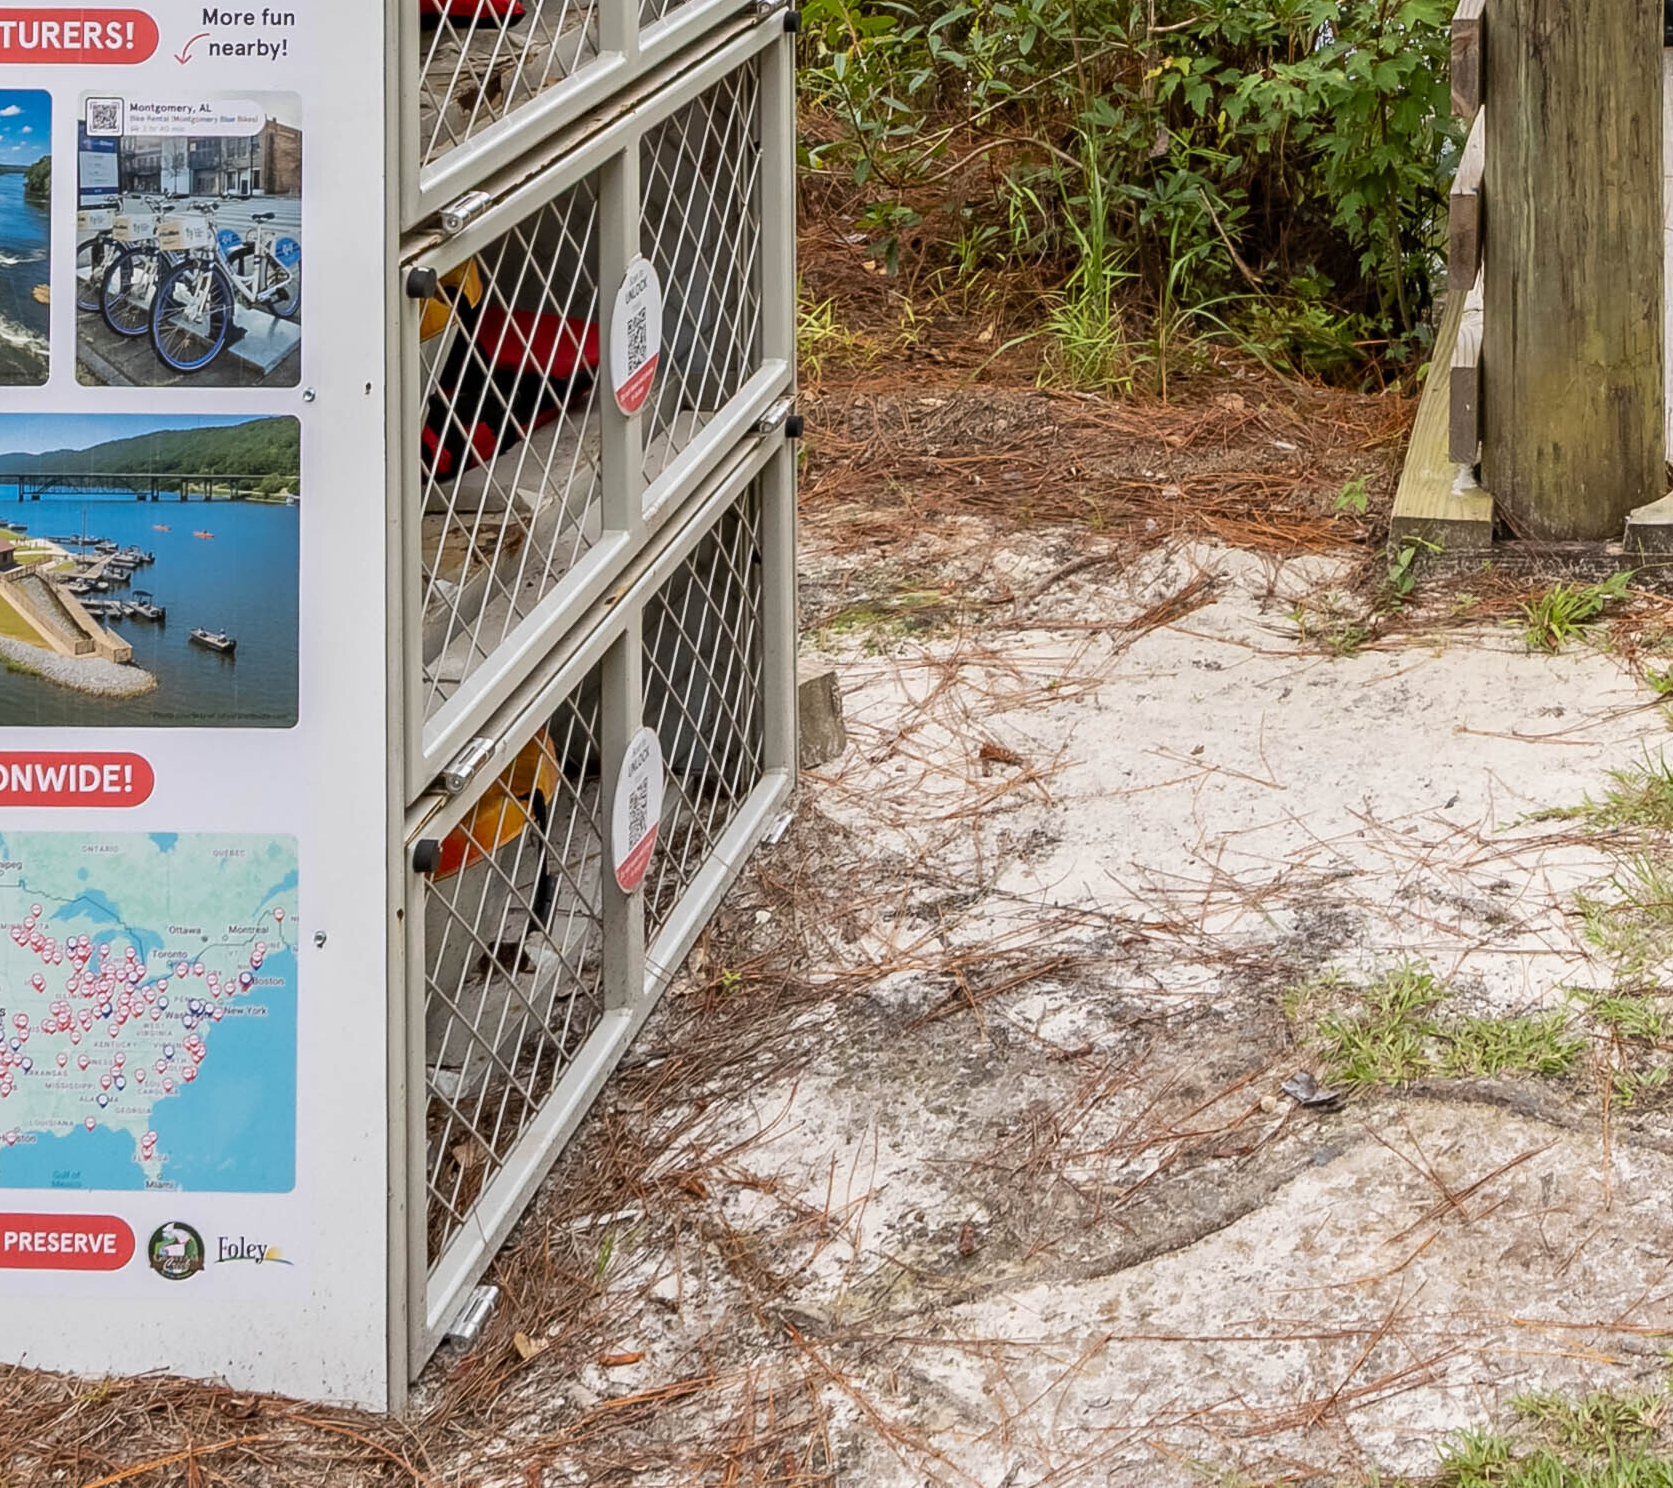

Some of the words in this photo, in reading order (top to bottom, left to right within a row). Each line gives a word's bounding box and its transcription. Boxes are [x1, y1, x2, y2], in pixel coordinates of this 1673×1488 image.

[202, 8, 254, 26] More
[261, 8, 295, 26] fun
[208, 38, 287, 60] nearby!
[130, 103, 196, 114] Montgomery,
[199, 104, 211, 112] AL
[5, 1231, 117, 1253] PRESERVE
[217, 1236, 267, 1264] Foley
